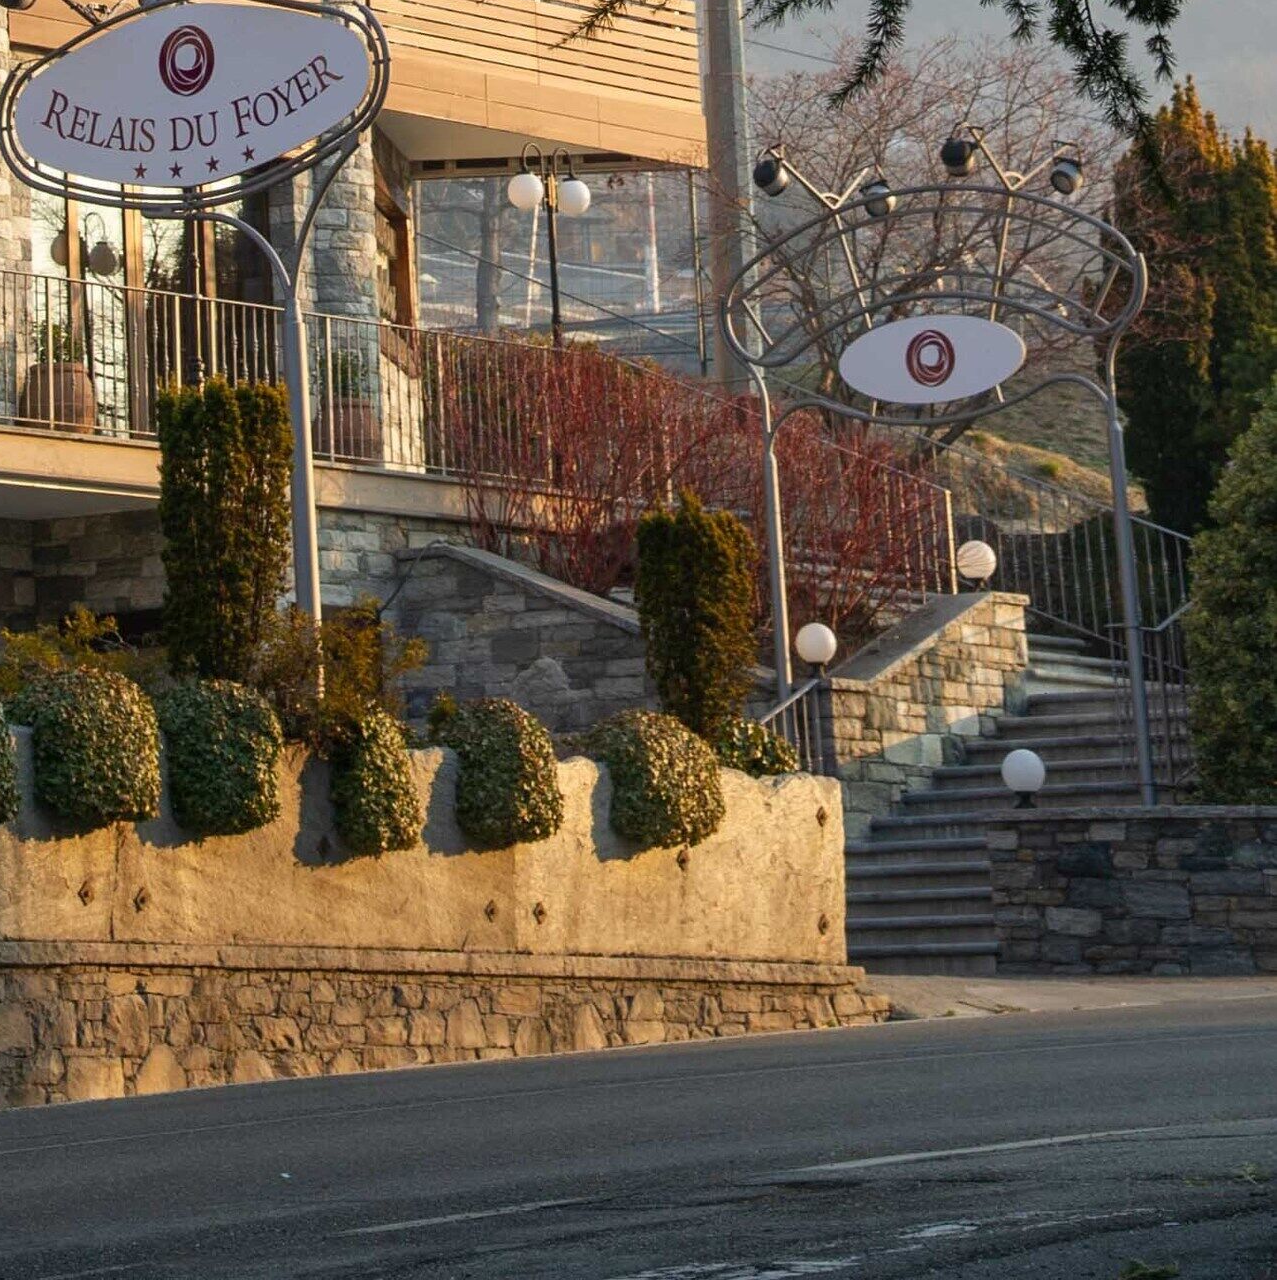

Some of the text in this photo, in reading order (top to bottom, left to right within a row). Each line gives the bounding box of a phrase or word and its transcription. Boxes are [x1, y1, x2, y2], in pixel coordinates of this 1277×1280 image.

[41, 54, 344, 153] RELAIS DU FOYER
